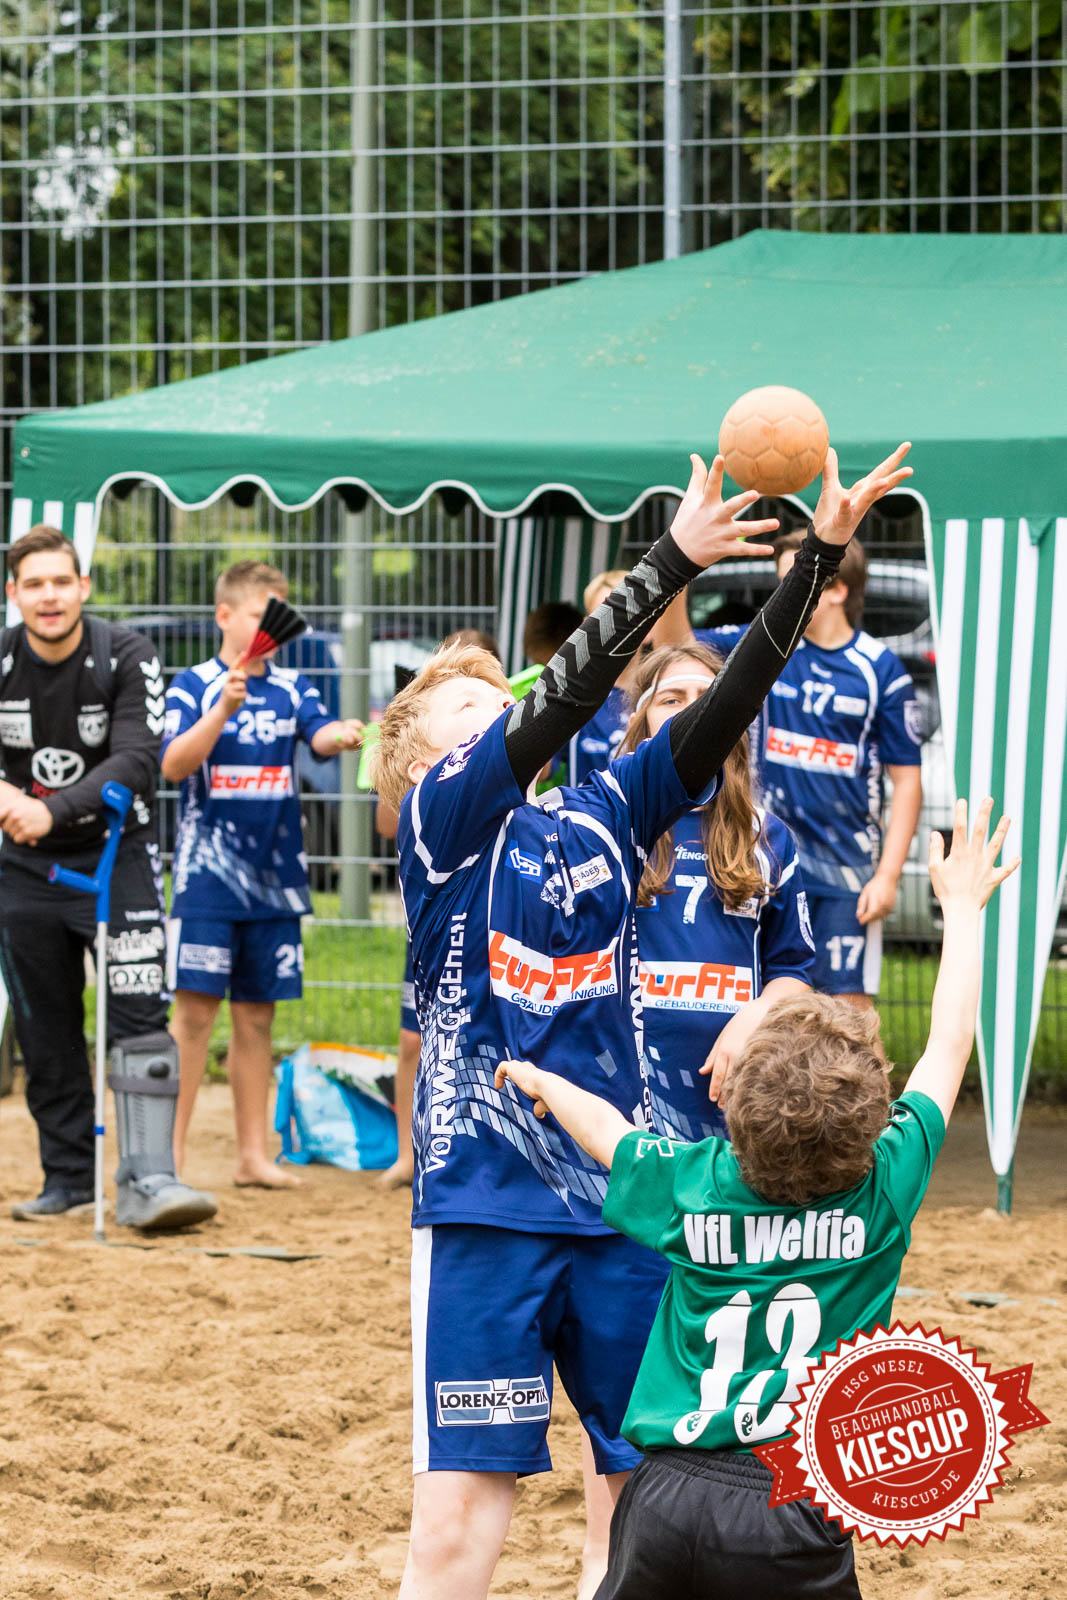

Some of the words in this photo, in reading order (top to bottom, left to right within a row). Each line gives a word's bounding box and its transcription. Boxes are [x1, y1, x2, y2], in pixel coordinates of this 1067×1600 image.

[801, 680, 835, 716] 17
[237, 710, 276, 745] 25
[674, 844, 709, 860] TENGO
[675, 874, 708, 924] 7
[826, 936, 865, 971] 17
[683, 1213, 738, 1264] VfL
[744, 1208, 865, 1264] Welfia
[440, 1387, 548, 1409] LORENZ-OPTIK
